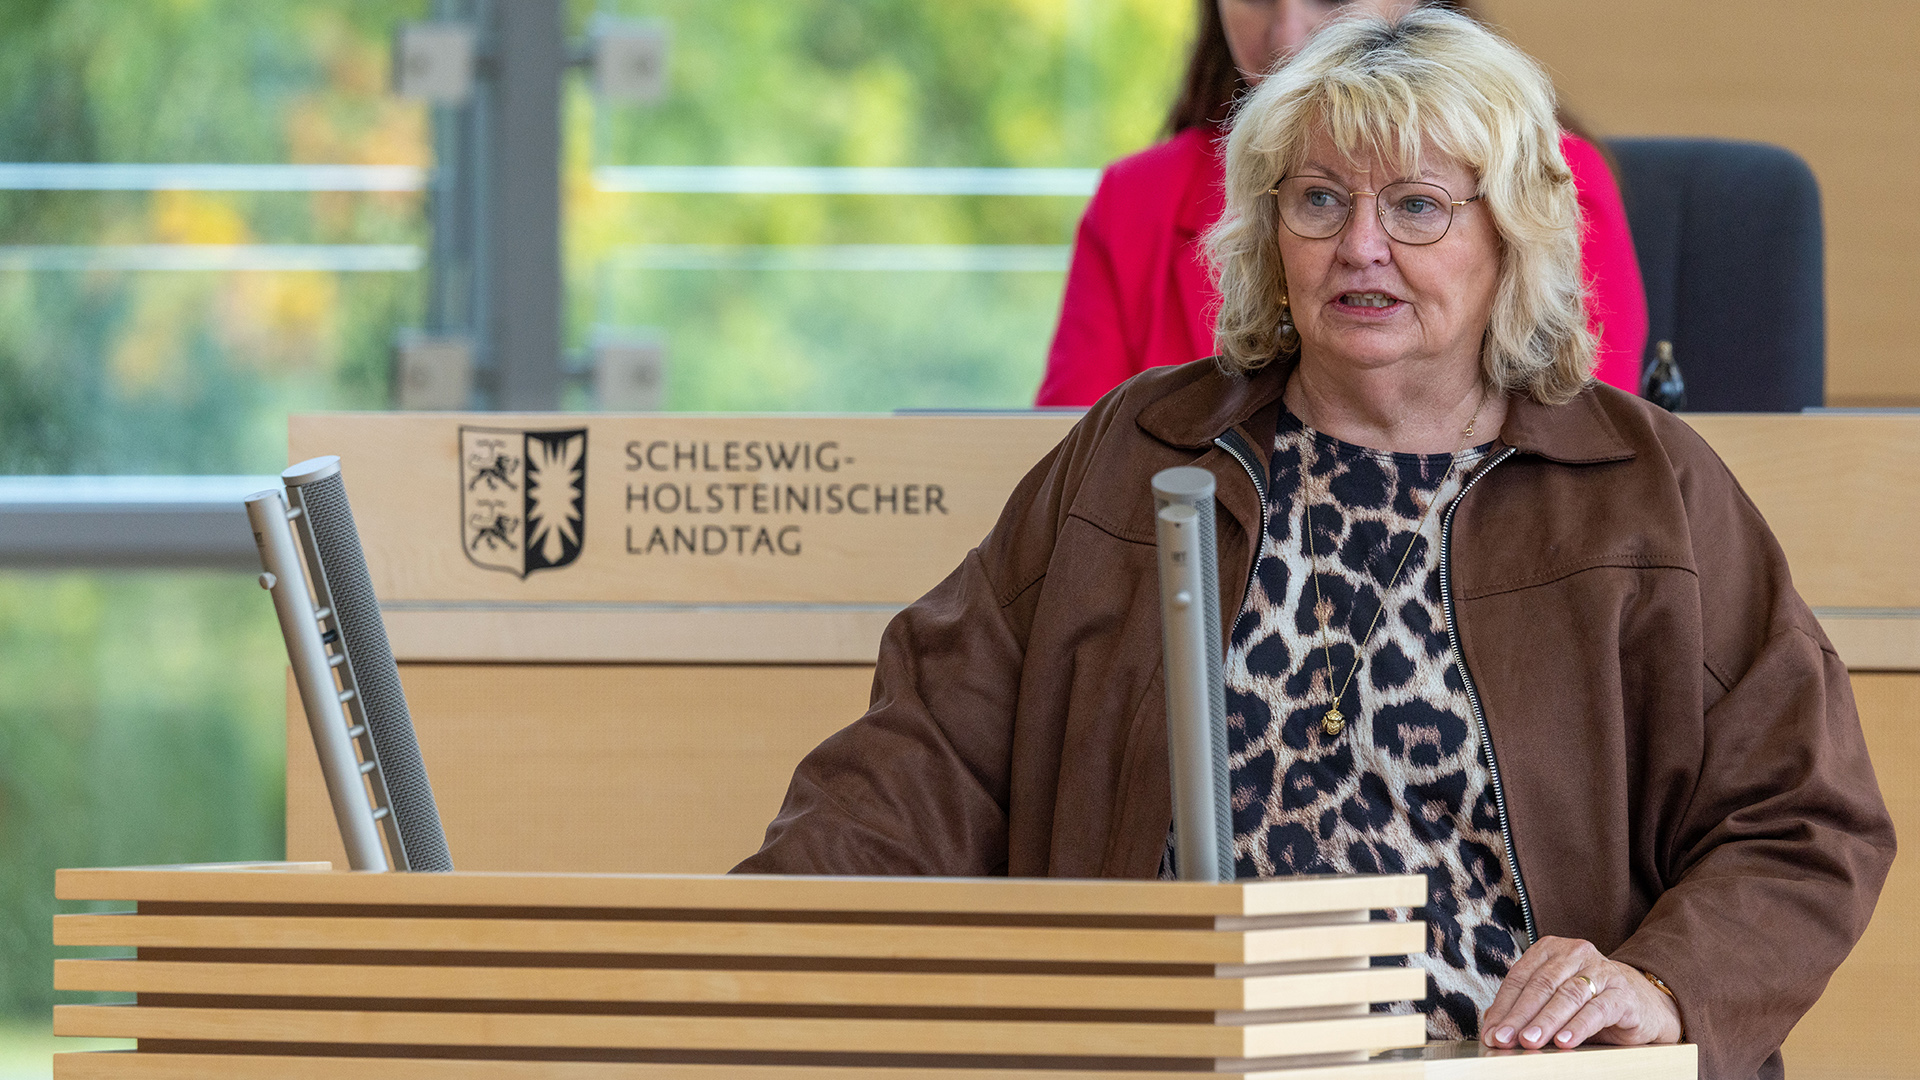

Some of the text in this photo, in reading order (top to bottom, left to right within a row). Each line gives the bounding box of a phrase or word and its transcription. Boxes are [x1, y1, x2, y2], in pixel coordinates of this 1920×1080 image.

[625, 441, 856, 471] SCHLESWIG-
[626, 483, 948, 515] HOLSTEINISCHER
[626, 525, 803, 555] LANDTAG
